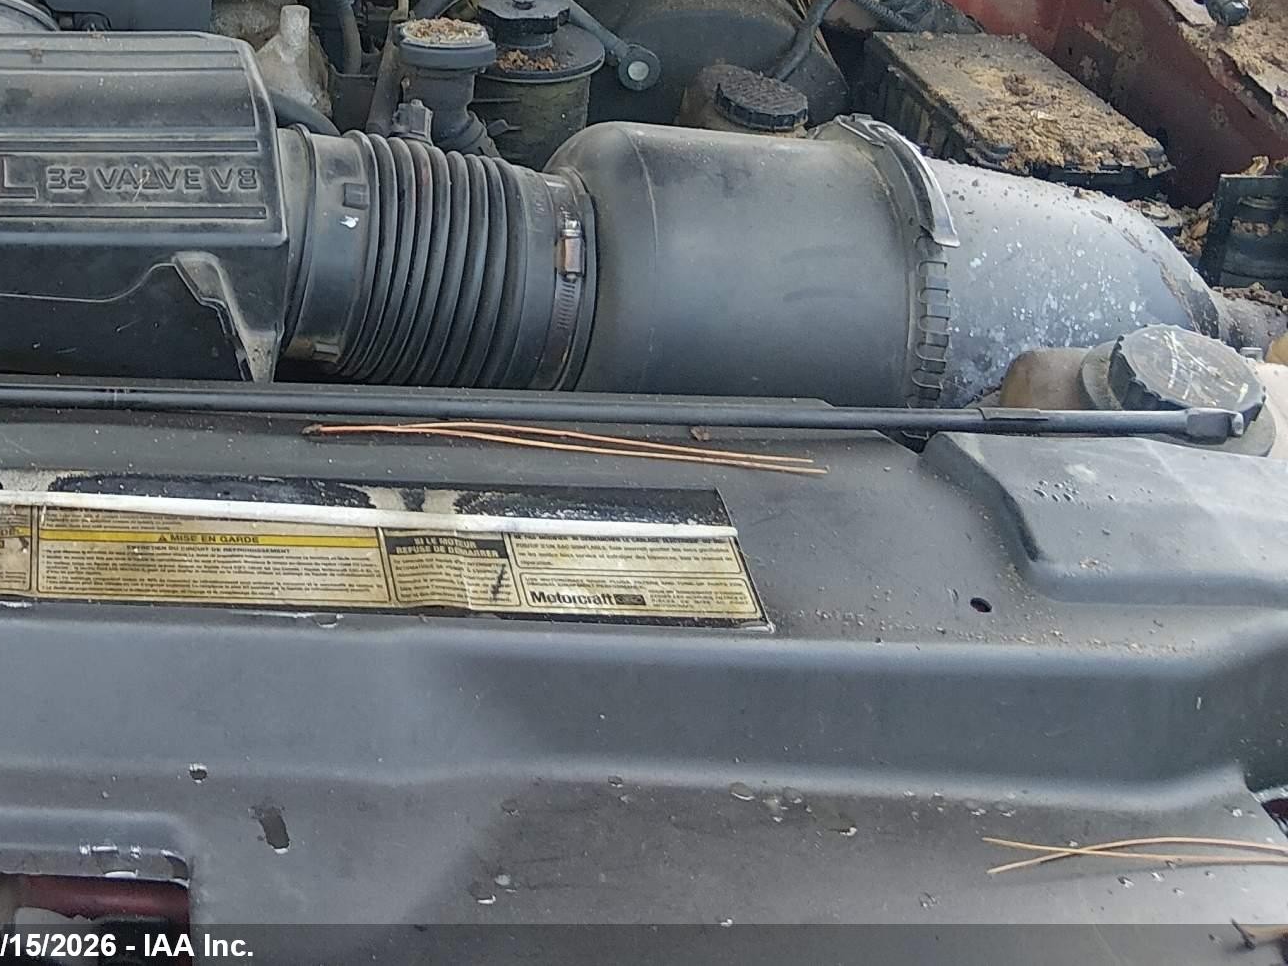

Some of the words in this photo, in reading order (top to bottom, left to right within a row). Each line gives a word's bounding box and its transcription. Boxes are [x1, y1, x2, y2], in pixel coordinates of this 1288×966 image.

[47, 167, 87, 191] 32
[96, 167, 202, 192] VALVE
[211, 168, 259, 191] V8
[170, 534, 196, 542] MISE
[201, 535, 216, 543] EN
[219, 535, 259, 544] GARDE
[528, 590, 615, 606] Motorcraft
